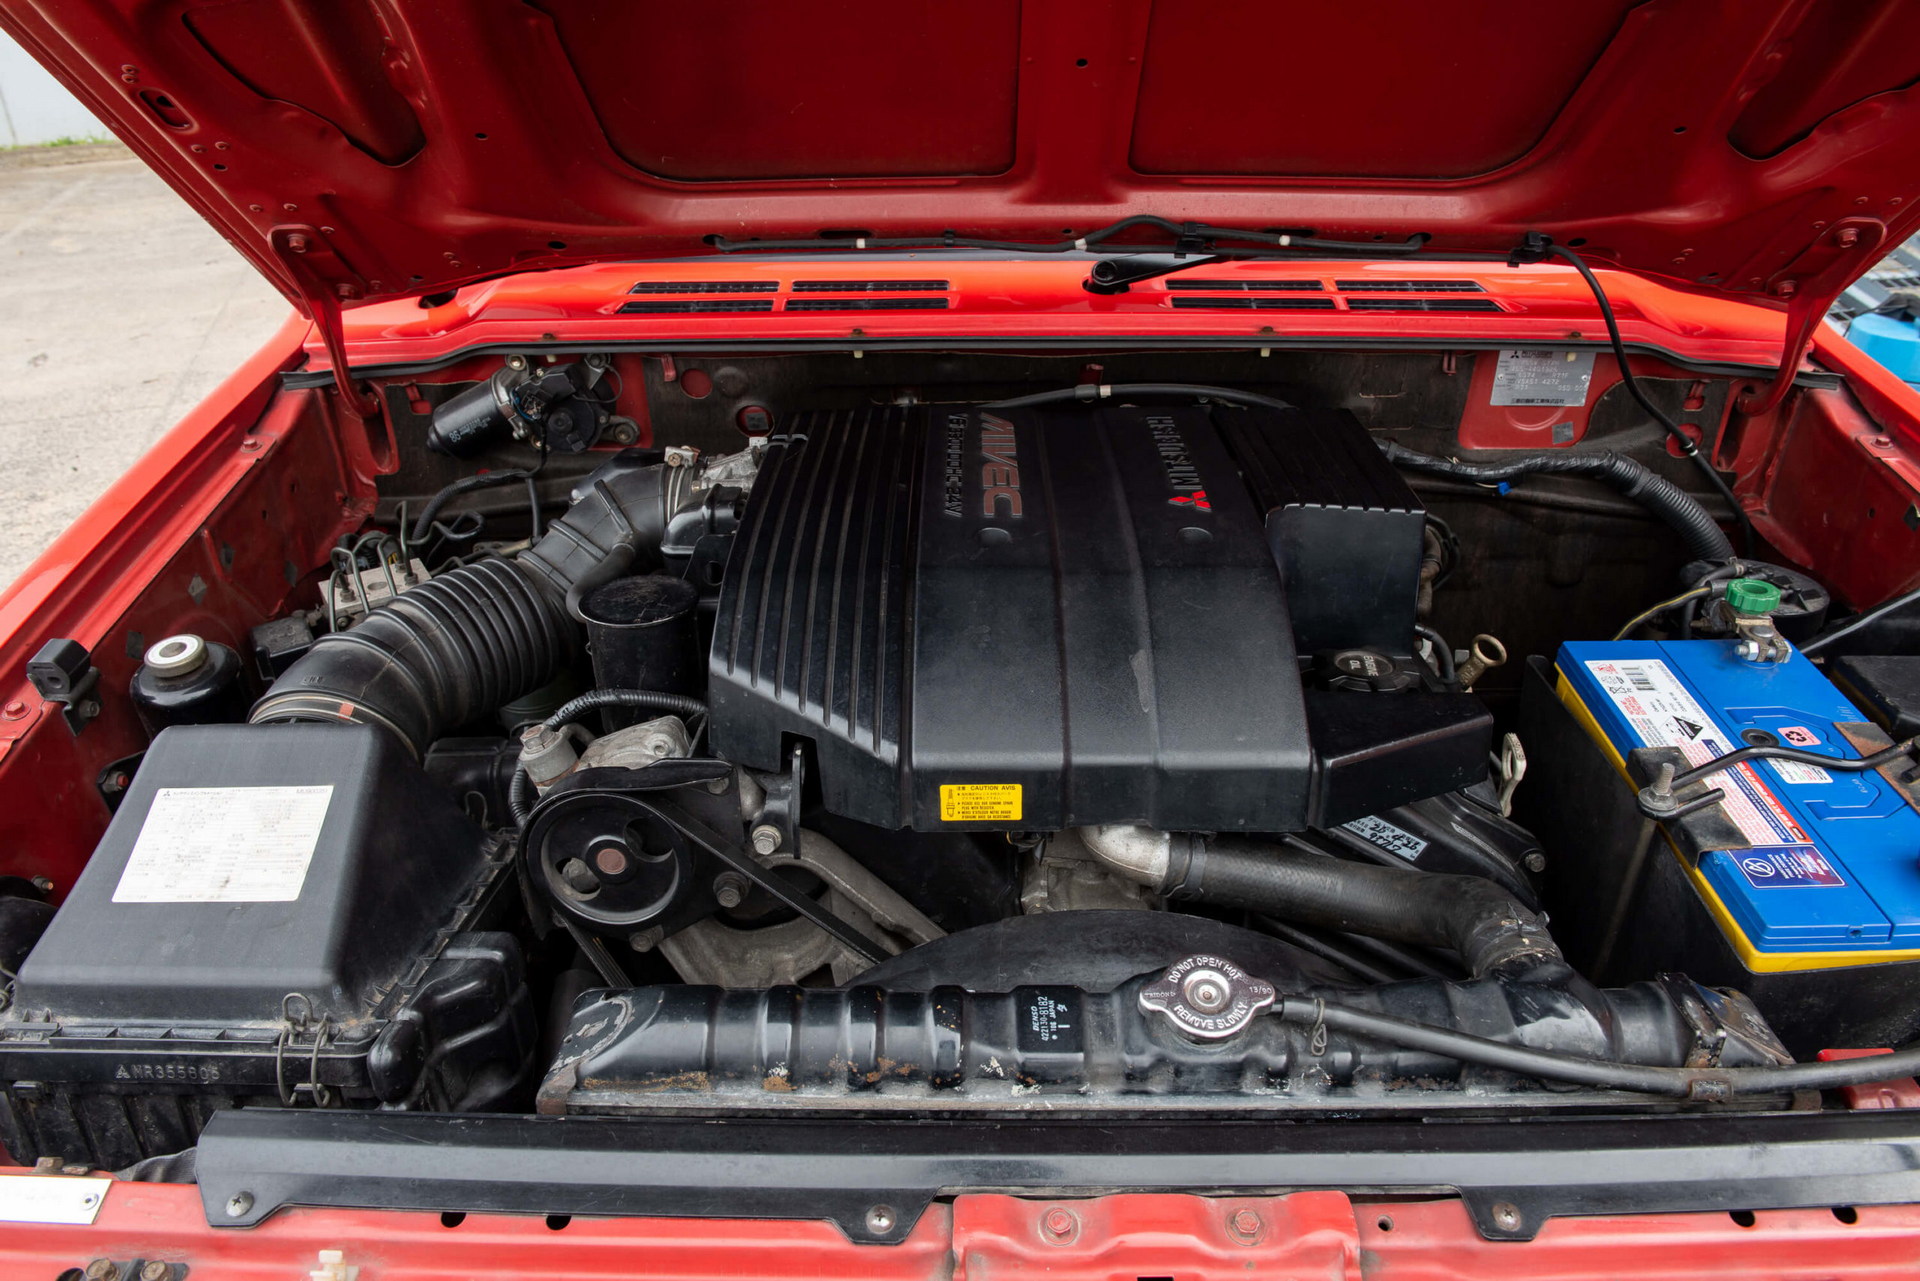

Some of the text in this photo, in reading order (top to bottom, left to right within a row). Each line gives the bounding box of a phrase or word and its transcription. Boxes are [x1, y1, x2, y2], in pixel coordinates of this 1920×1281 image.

[979, 412, 1023, 518] MIVEC
[1168, 957, 1242, 983] DO NOT OPEN HOT
[1031, 1006, 1040, 1031] DENSO
[1174, 1001, 1248, 1029] REMOVE SLOWLY
